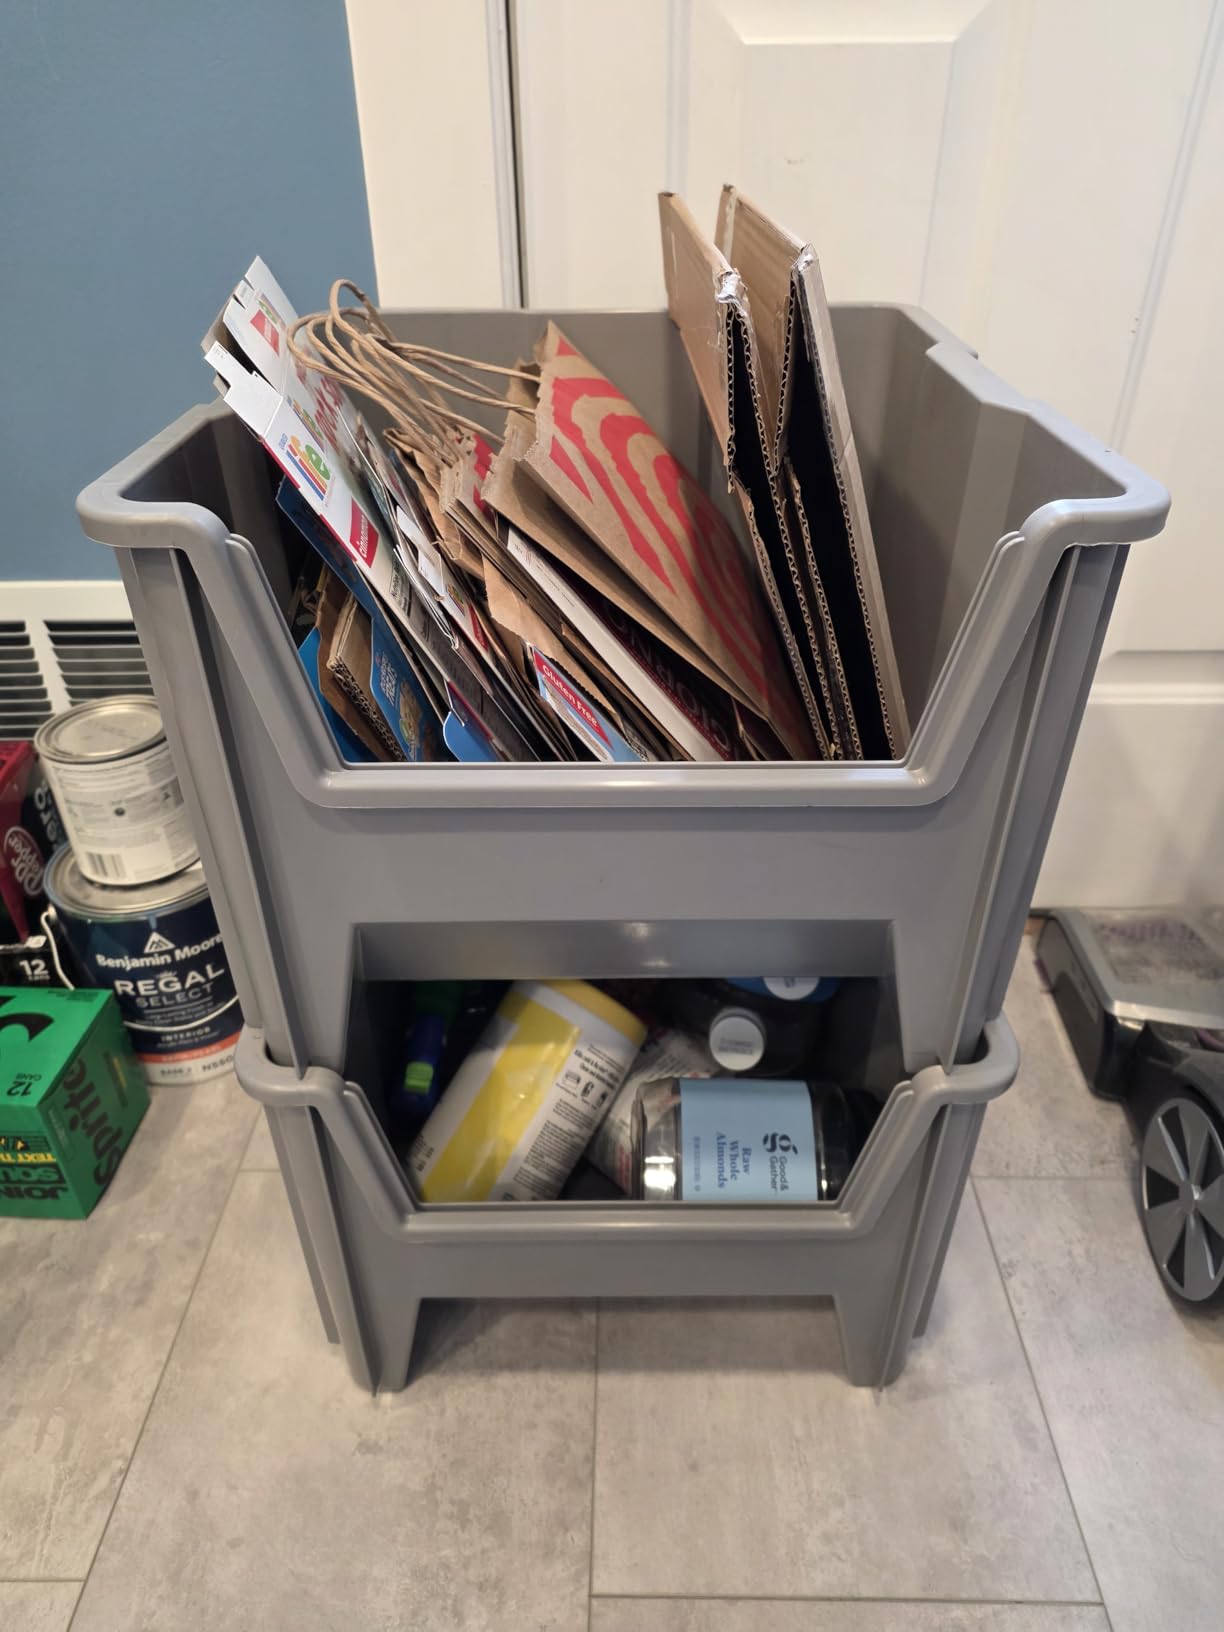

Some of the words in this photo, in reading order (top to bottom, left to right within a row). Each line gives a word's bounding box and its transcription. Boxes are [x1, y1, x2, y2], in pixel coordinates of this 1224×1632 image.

[286, 434, 331, 502] life
[542, 664, 576, 704] Gluten
[576, 700, 599, 727] Free
[19, 959, 49, 976] 12
[95, 953, 173, 972] Benjamin
[114, 963, 225, 997] REGAL
[136, 982, 214, 1008] SELECT
[6, 1080, 34, 1097] 12
[716, 1131, 729, 1189] Almonds
[729, 1140, 741, 1181] Whole
[741, 1147, 753, 1176] Raw
